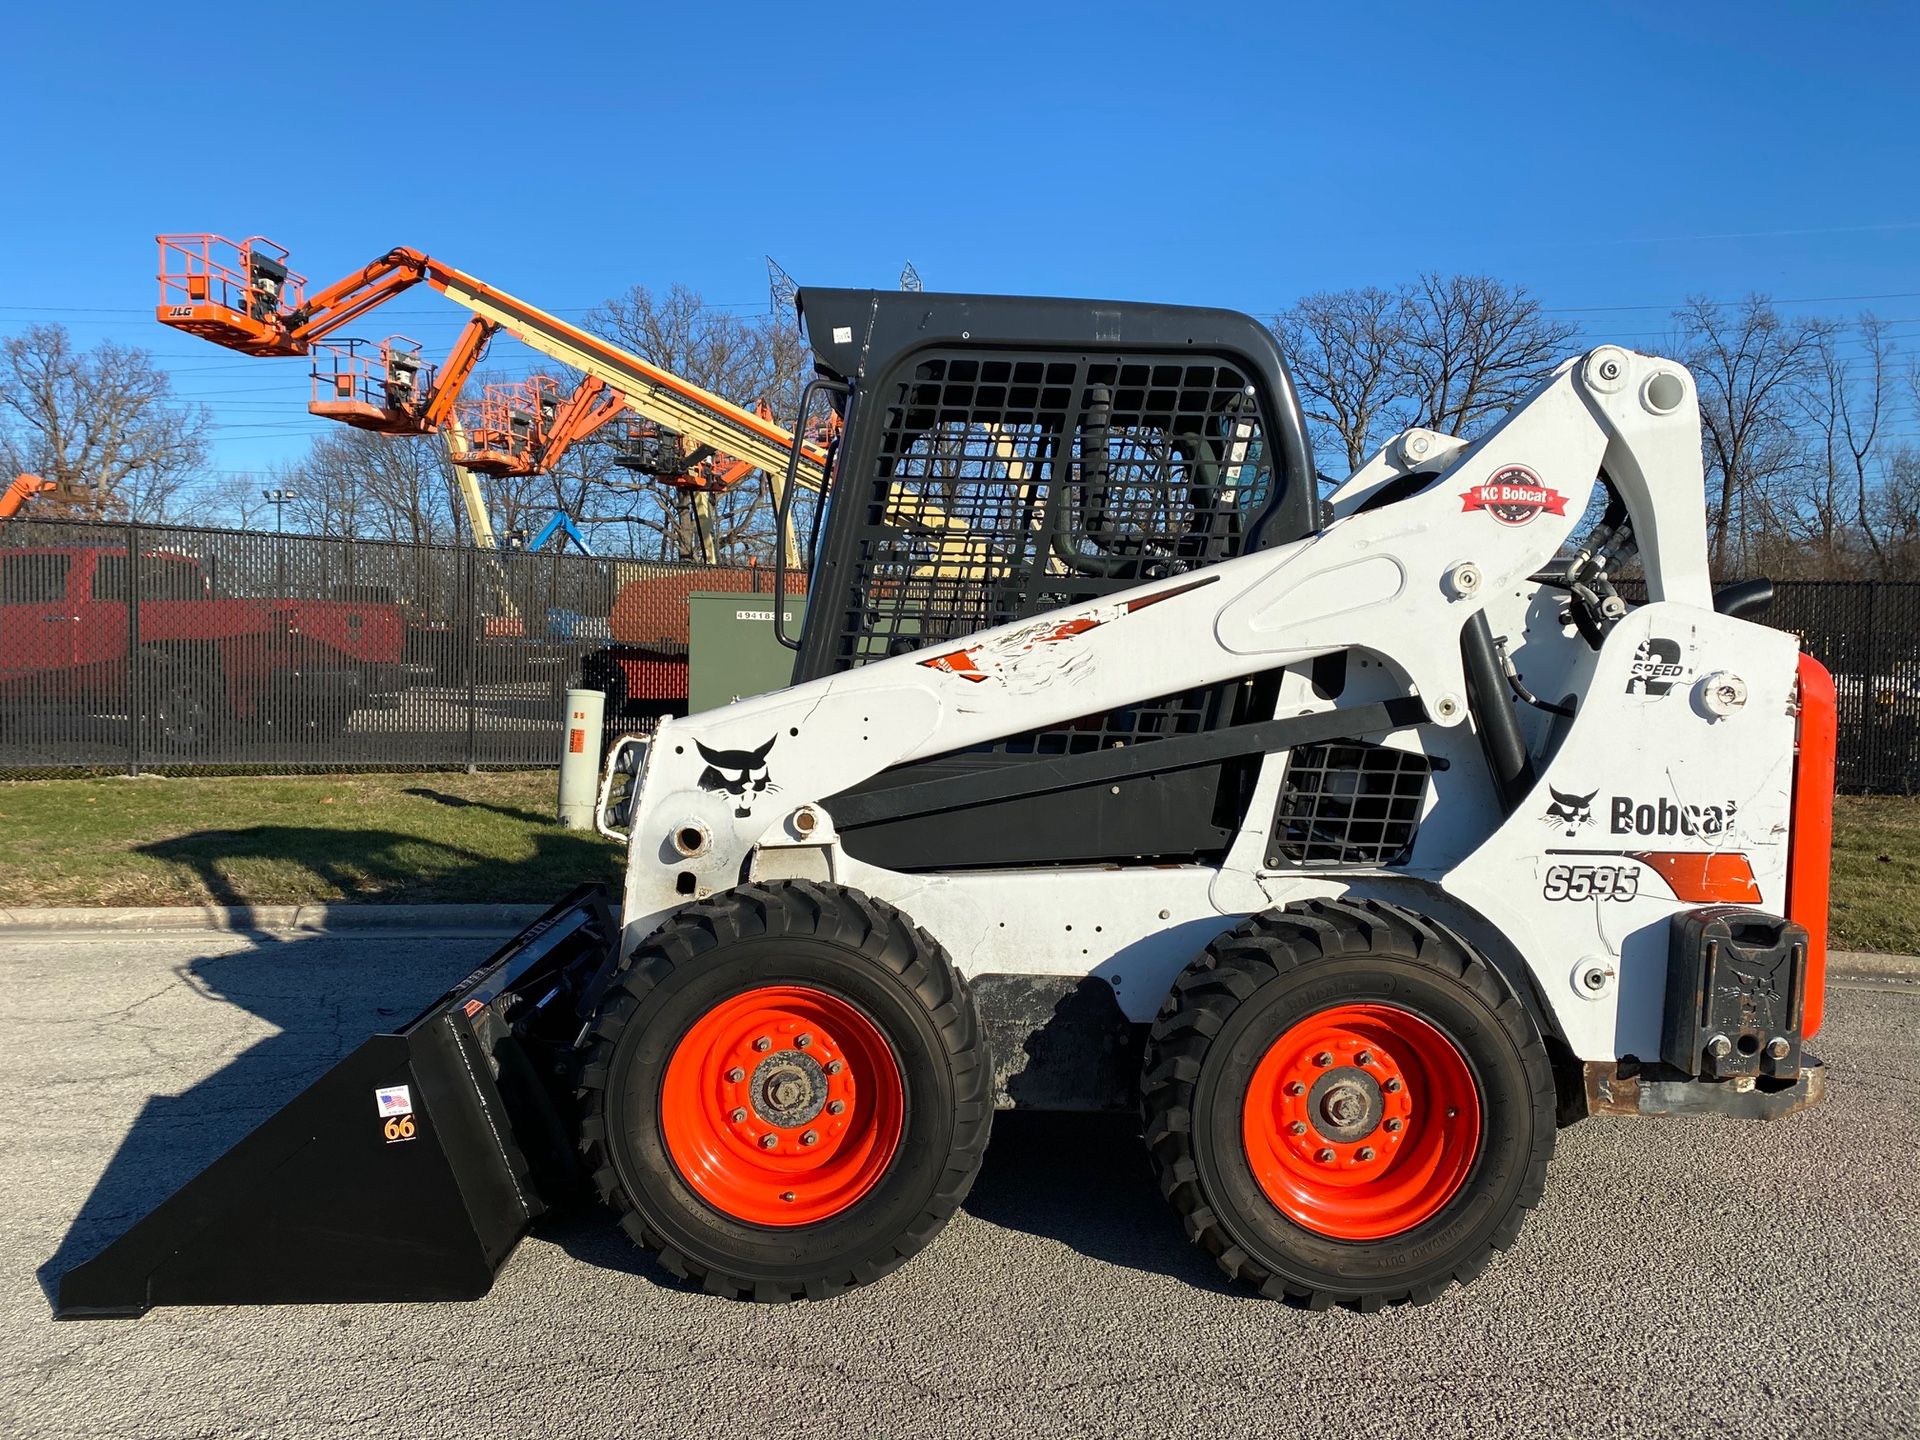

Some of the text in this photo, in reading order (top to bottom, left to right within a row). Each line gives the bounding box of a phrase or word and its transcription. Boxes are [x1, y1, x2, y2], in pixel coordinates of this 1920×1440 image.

[169, 307, 192, 316] JLG
[1480, 486, 1548, 503] KC Bobcat
[1625, 638, 1682, 697] 2
[1630, 663, 1684, 677] SPEED
[1543, 864, 1641, 903] S595
[1375, 1222, 1465, 1270] STANDARD DUTY
